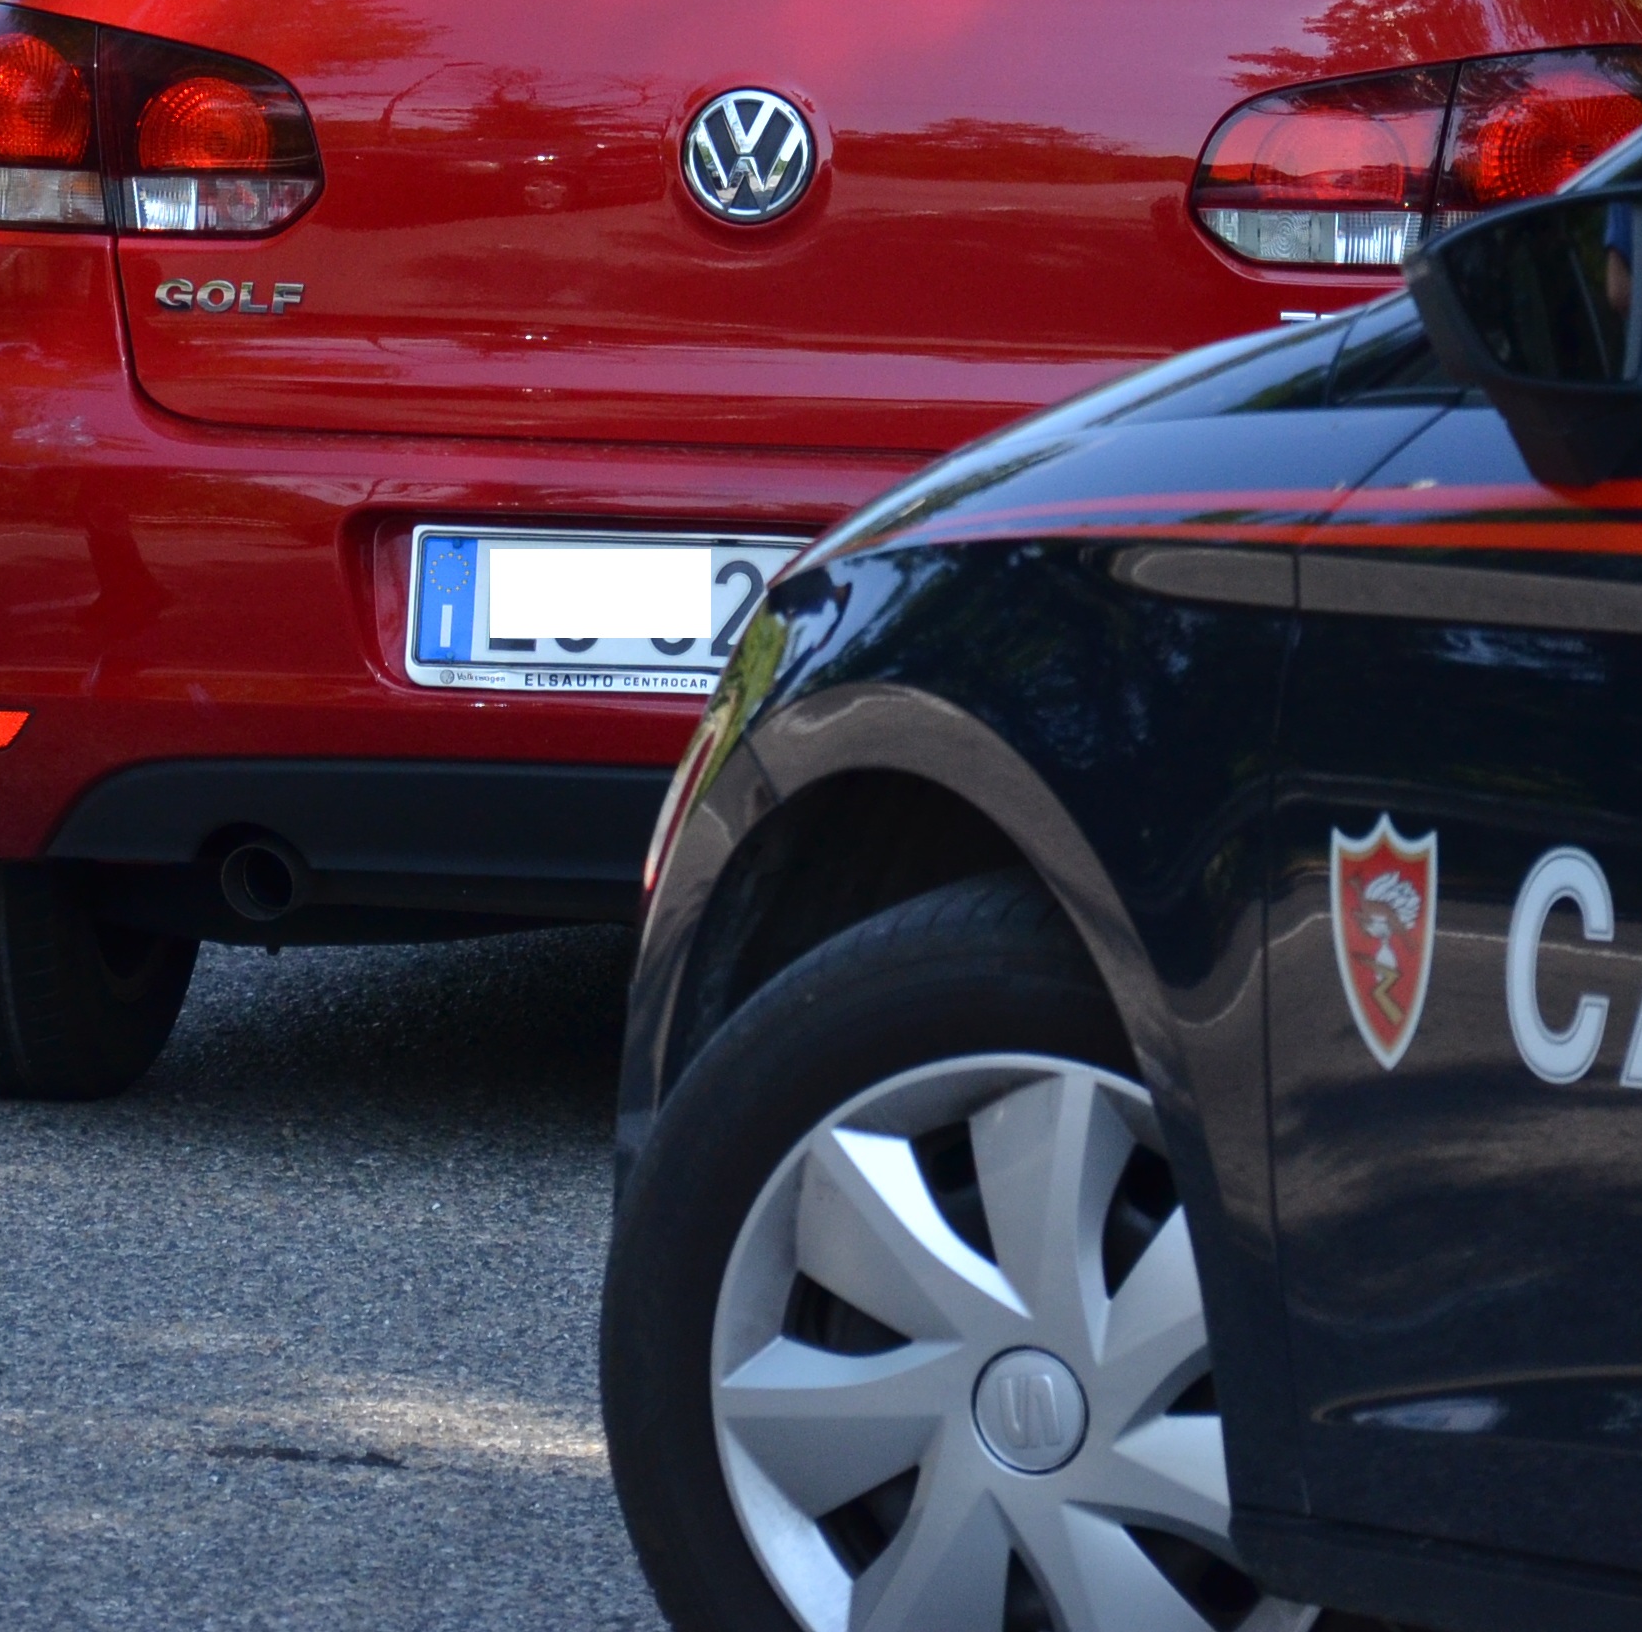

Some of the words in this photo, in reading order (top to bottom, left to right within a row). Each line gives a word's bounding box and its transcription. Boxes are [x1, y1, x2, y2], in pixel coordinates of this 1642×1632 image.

[155, 278, 304, 314] GOLF
[524, 673, 614, 688] ELSAUTO
[623, 675, 708, 689] CENTROCAR
